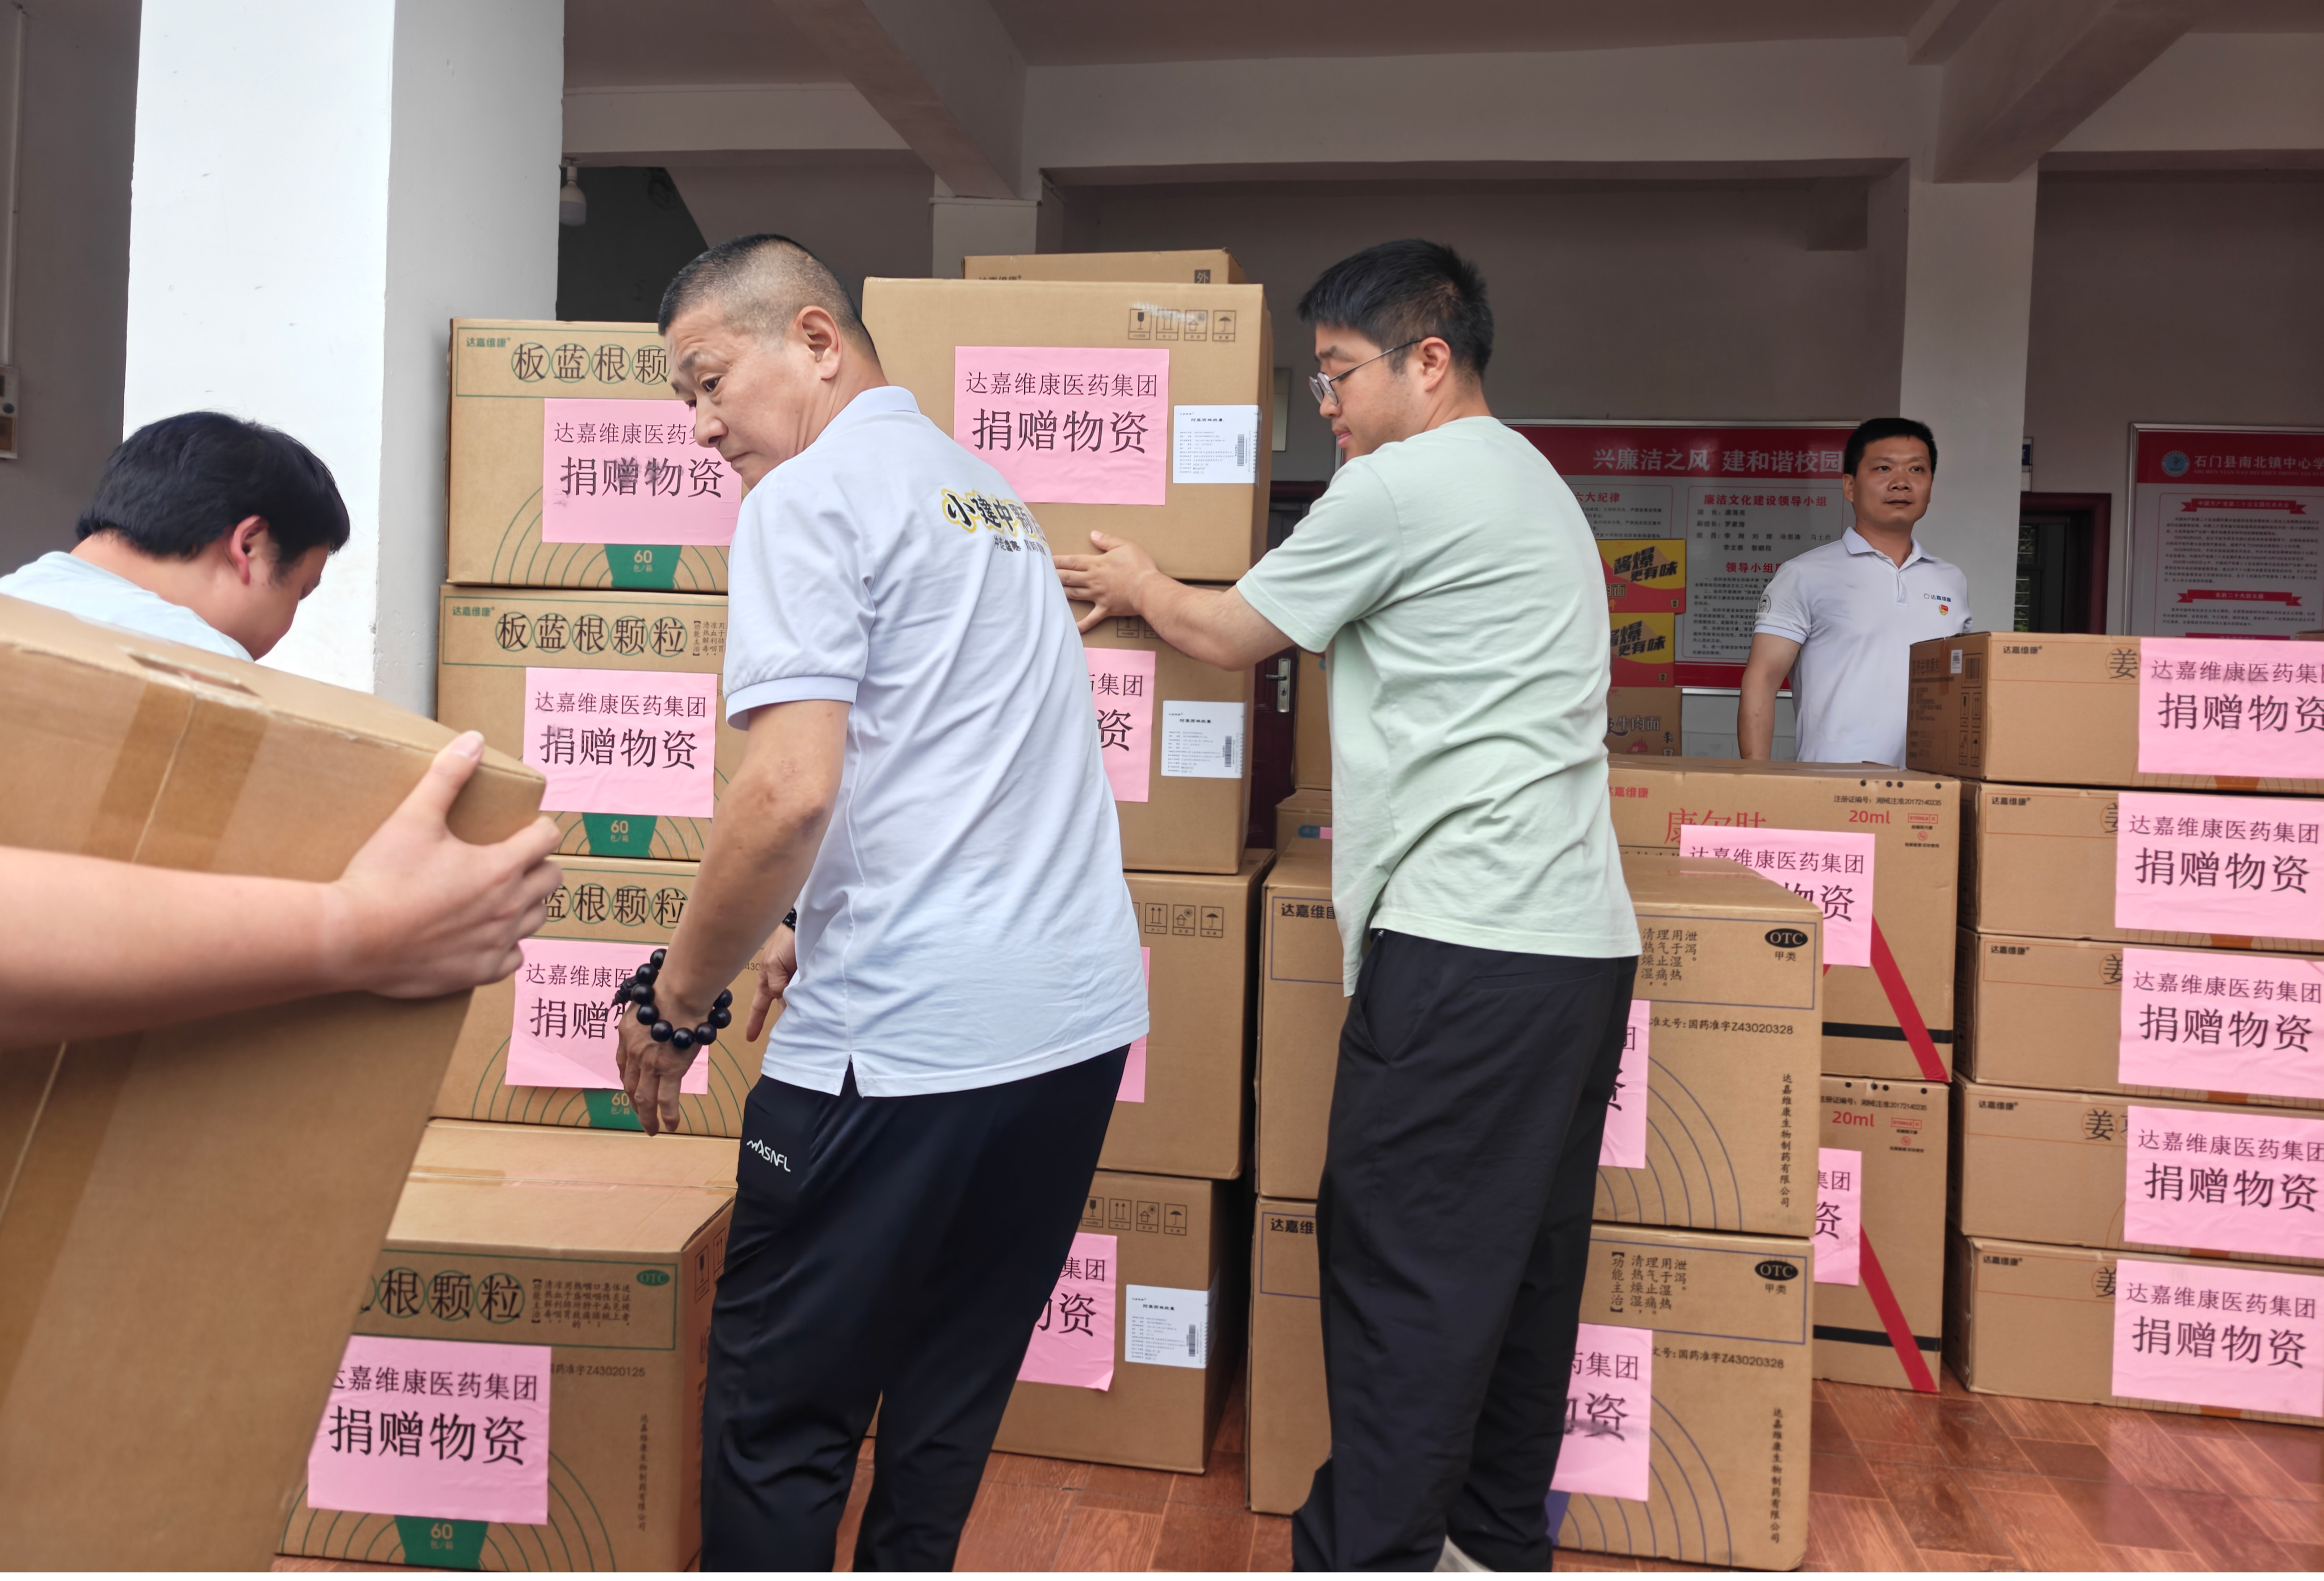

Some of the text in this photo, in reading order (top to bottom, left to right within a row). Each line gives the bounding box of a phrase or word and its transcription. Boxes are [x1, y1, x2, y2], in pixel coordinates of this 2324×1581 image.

[466, 338, 507, 348] 达嘉维康
[513, 343, 668, 383] 板蓝根颗
[966, 372, 1158, 398] 达嘉维康医药集团
[971, 408, 1150, 454] 捐赠物资
[1593, 448, 1844, 473] 兴廉洁之风 建和谐校园
[2194, 456, 2324, 470] 石门县南北镇中心学
[560, 456, 725, 498] 捐赠物资
[1575, 492, 1620, 503] 六大纪律
[1704, 494, 1827, 507] 廉洁文化建设领导小组
[634, 550, 653, 563] 60
[1614, 546, 1655, 575] 酱爆
[1630, 561, 1678, 583] 更有味
[452, 606, 490, 617] 达嘉维康
[496, 613, 684, 655] 板蓝根颗粒
[1618, 635, 1666, 657] 更有味
[2003, 646, 2038, 655] 达嘉维康
[2108, 648, 2138, 680] 姜
[2151, 659, 2324, 684] 达嘉维康医药集
[534, 690, 706, 718] 达嘉维康医药集团
[2157, 692, 2324, 733] 捐赠物资
[1097, 709, 1134, 752] 资
[540, 724, 697, 770] 捐赠物资
[1992, 796, 2027, 806] 达嘉维康
[611, 820, 629, 834] 60
[1849, 810, 1891, 824] 20ml
[2129, 813, 2321, 845] 达嘉维康医药集团
[2134, 846, 2310, 894] 捐赠物资
[1770, 932, 1804, 945] OTC
[1670, 930, 1683, 981] 用于湿热
[1775, 951, 1796, 962] 甲类
[2133, 971, 2322, 1004] 达嘉维康医药集团
[2139, 1003, 2313, 1053] 捐赠物资
[612, 1092, 631, 1106] 60
[1832, 1111, 1875, 1127] 20ml
[1779, 1073, 1793, 1208] 达嘉维康生物制药有限公司
[2138, 1129, 2324, 1163] 达嘉维康医药集团
[2145, 1162, 2318, 1212] 捐赠物资
[1815, 1201, 1843, 1240] 资
[639, 1272, 667, 1283] OTC
[1610, 1251, 1624, 1313] 【功能主治】
[1659, 1258, 1673, 1310] 用于湿热
[1759, 1264, 1793, 1278] OTC
[361, 1269, 521, 1321] 根颗粒
[1765, 1283, 1787, 1295] 甲类
[2126, 1282, 2316, 1319] 达嘉维康医药集团
[2132, 1316, 2308, 1369] 捐赠物资
[329, 1405, 527, 1466] 捐赠物资
[1770, 1407, 1783, 1544] 达嘉维康生物制药有限公司
[430, 1523, 453, 1540] 60
